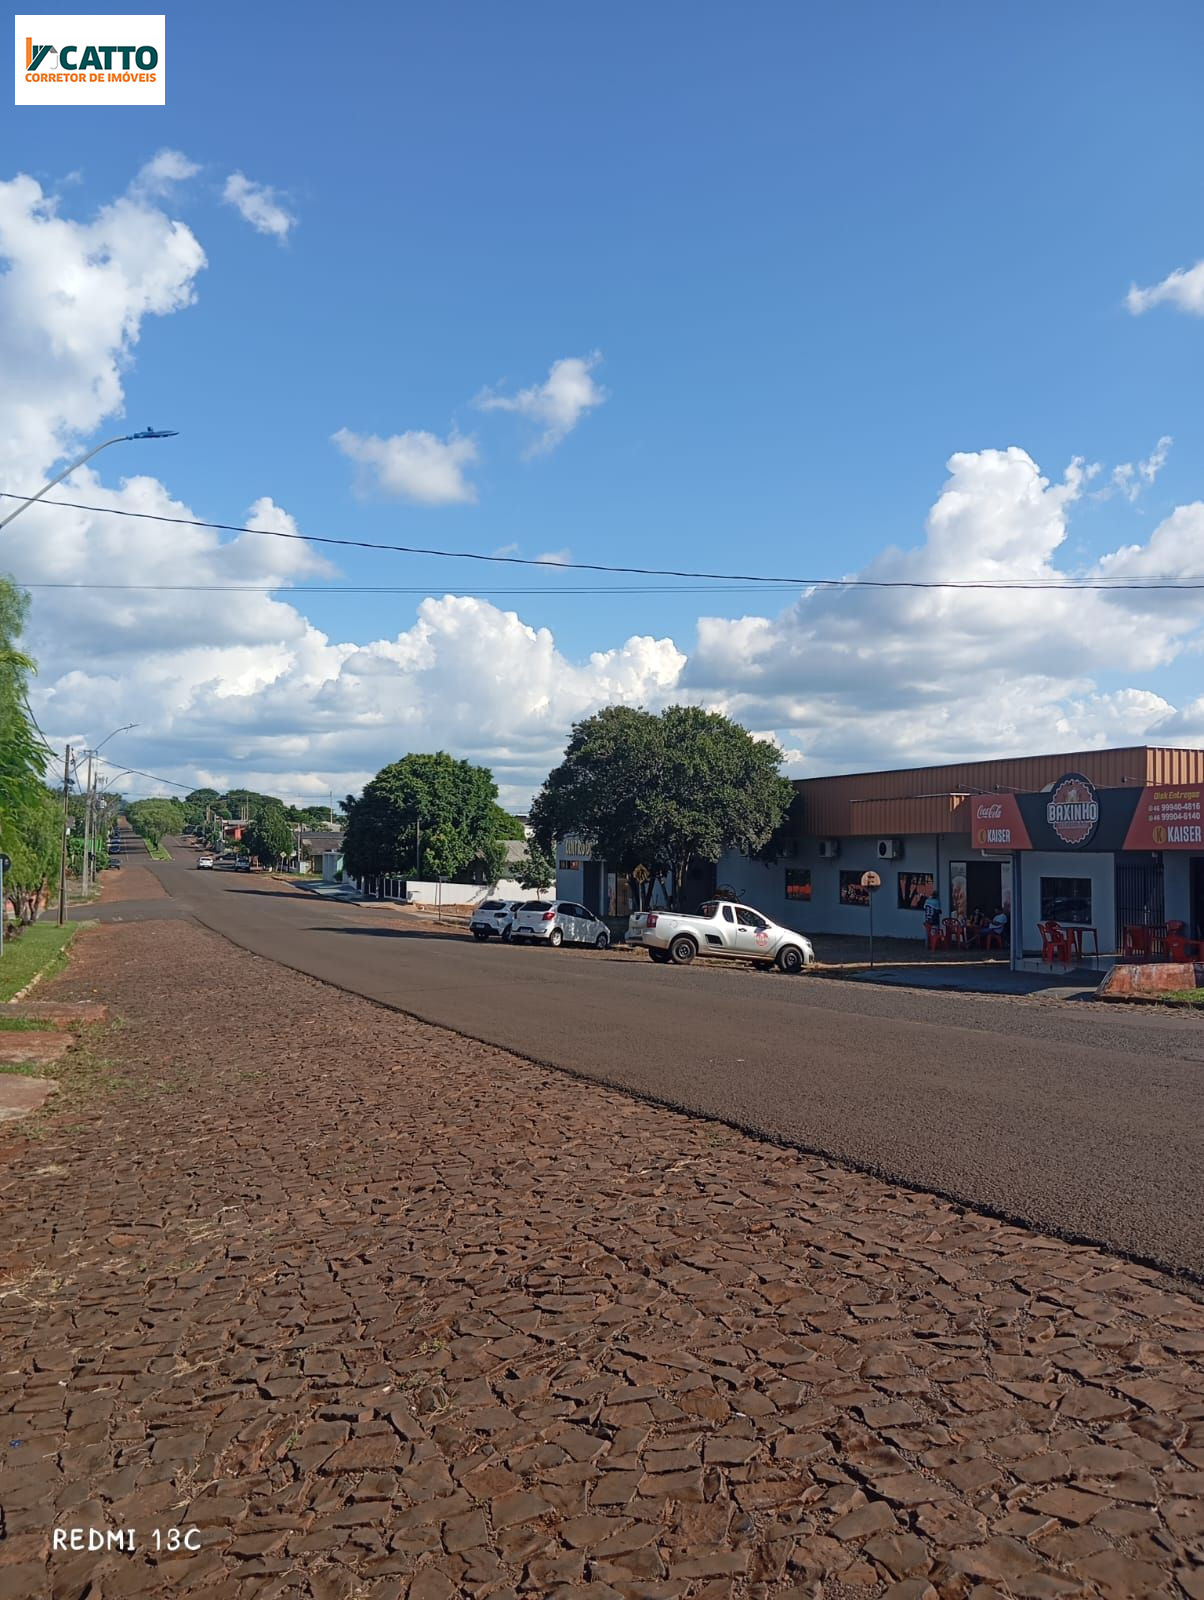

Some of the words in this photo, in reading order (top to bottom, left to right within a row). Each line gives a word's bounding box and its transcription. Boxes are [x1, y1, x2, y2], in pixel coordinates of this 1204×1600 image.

[1049, 803, 1097, 821] BAXINHO
[987, 829, 1011, 843] KAISER
[1167, 825, 1202, 843] KAISER
